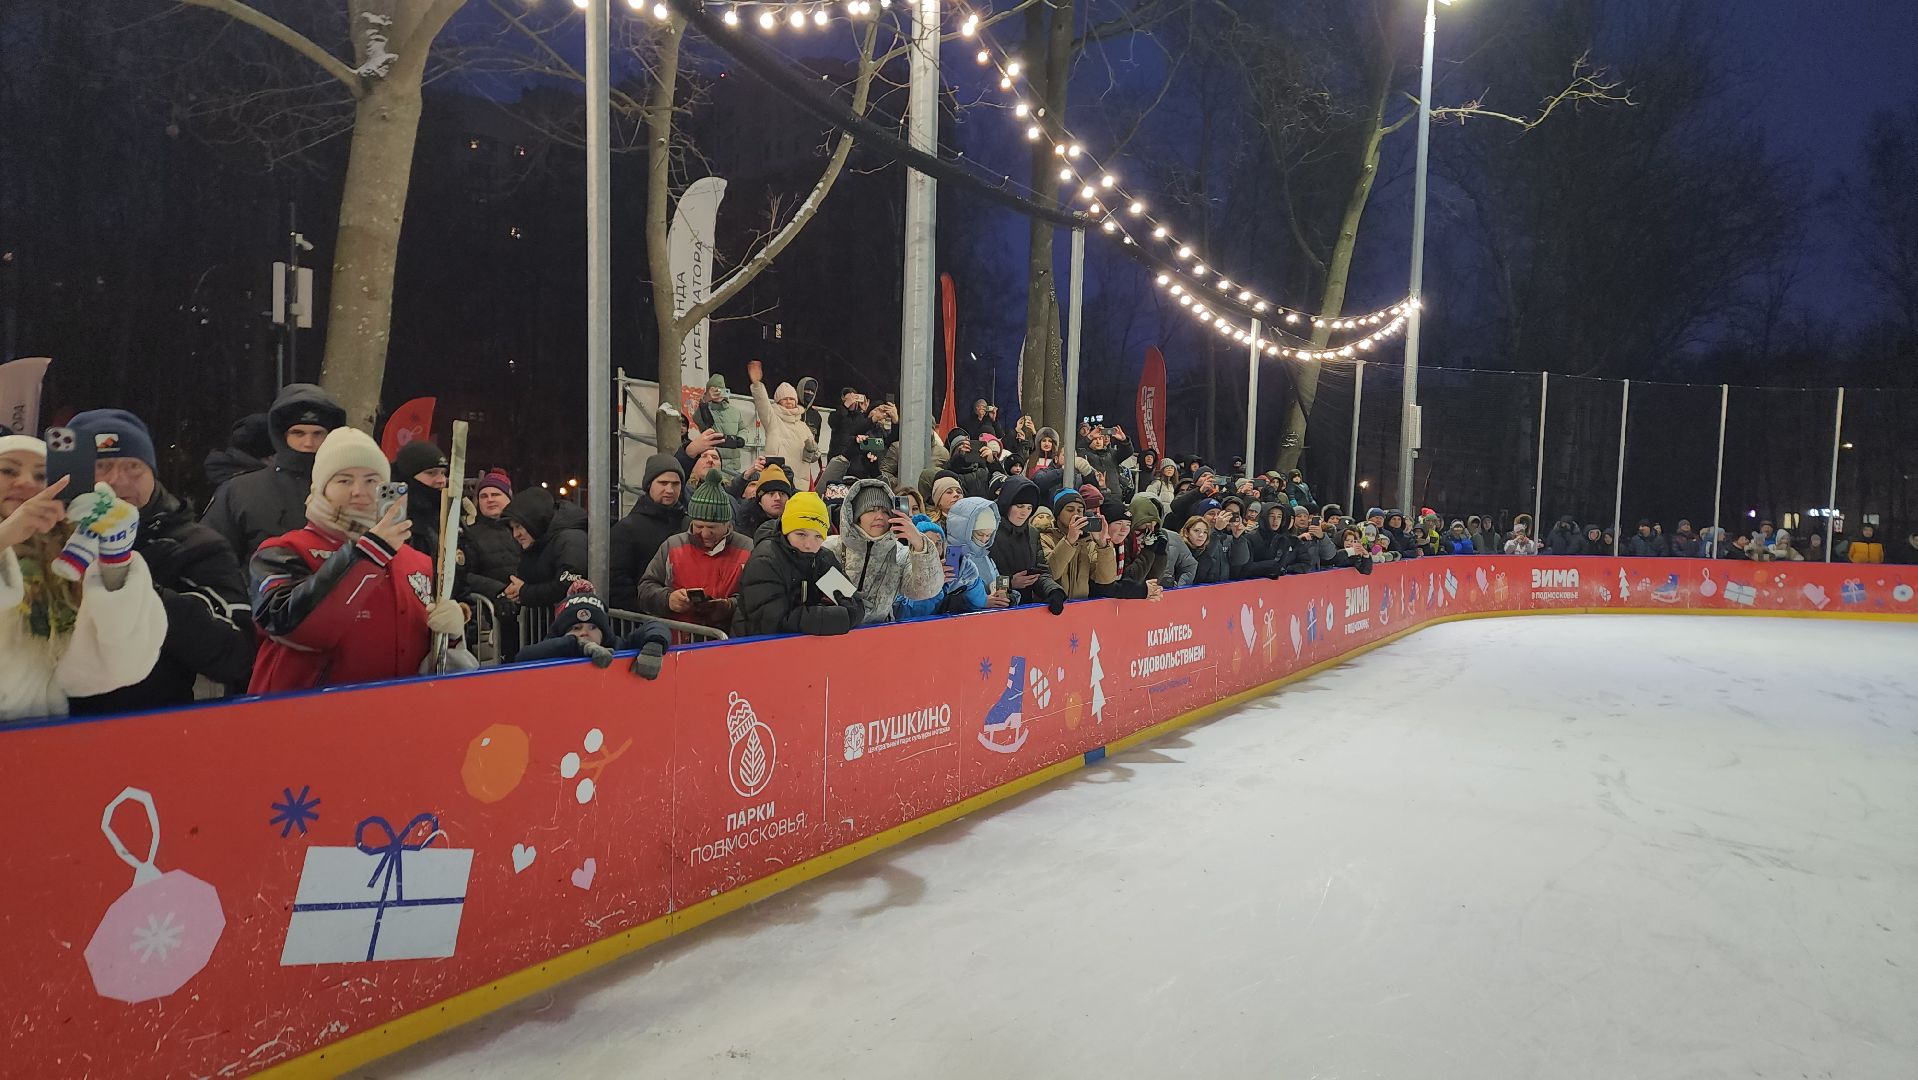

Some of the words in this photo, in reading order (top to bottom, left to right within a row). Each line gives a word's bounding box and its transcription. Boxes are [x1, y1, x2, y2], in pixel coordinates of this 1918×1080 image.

[675, 272, 688, 368] КОНДА
[1531, 568, 1580, 588] ЗИМА
[1344, 584, 1370, 618] ЗИМА
[1147, 622, 1192, 647] КАТАЙТЕСЬ
[1130, 660, 1137, 678] С
[1137, 644, 1206, 678] УДОВОЛЬСТВИЕМ!
[868, 703, 951, 746] ПУШКИНО
[726, 800, 775, 832] ПАРКИ
[690, 811, 806, 867] ПОДМОСКОВЬЯ
